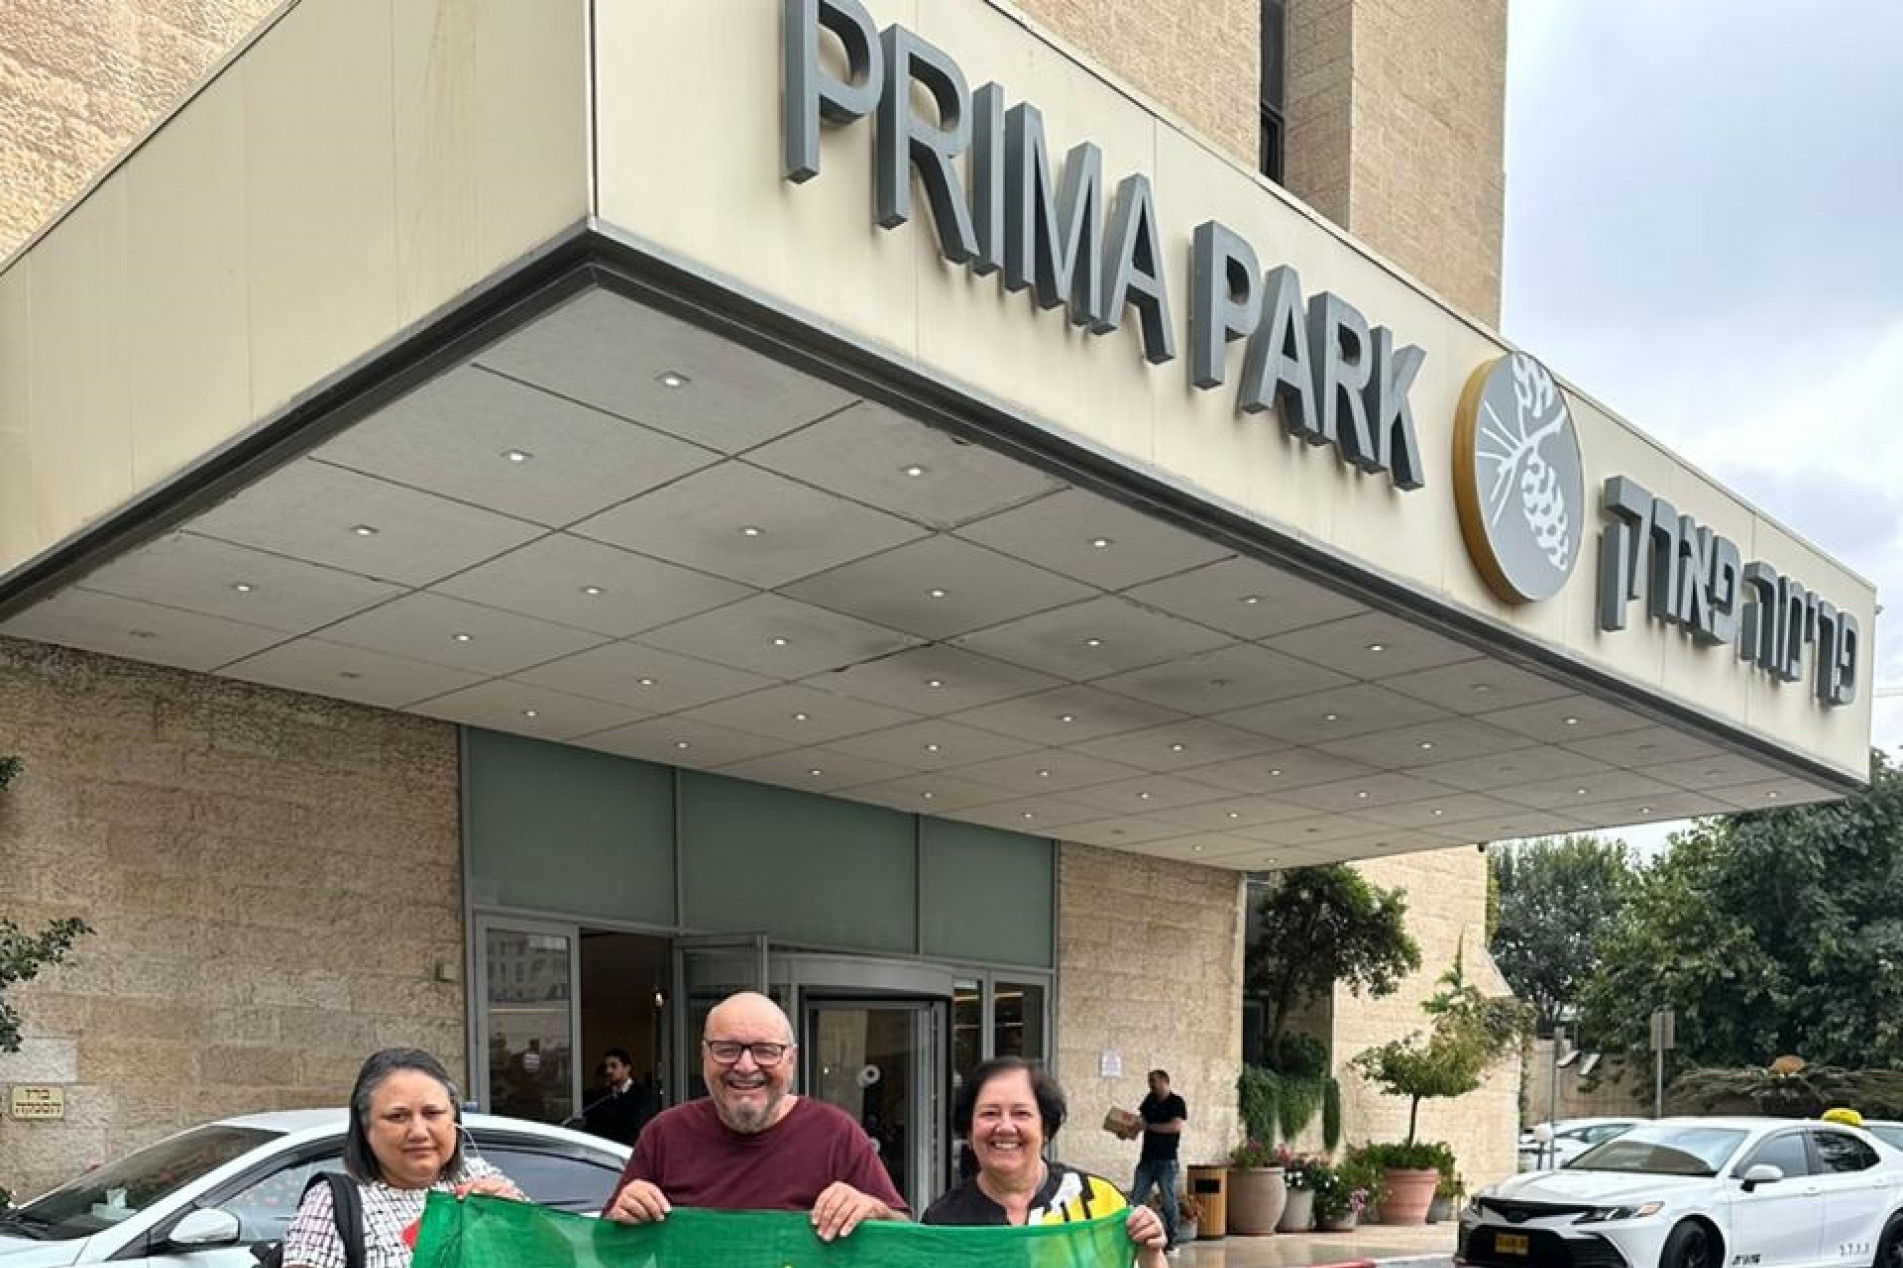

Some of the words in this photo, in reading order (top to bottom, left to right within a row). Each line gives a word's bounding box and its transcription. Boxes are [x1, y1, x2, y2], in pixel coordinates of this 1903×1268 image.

[785, 0, 1174, 365] PRIMA
[1194, 220, 1427, 491] PARK
[1601, 475, 1743, 645] פארק
[1740, 561, 1860, 706] פרימה
